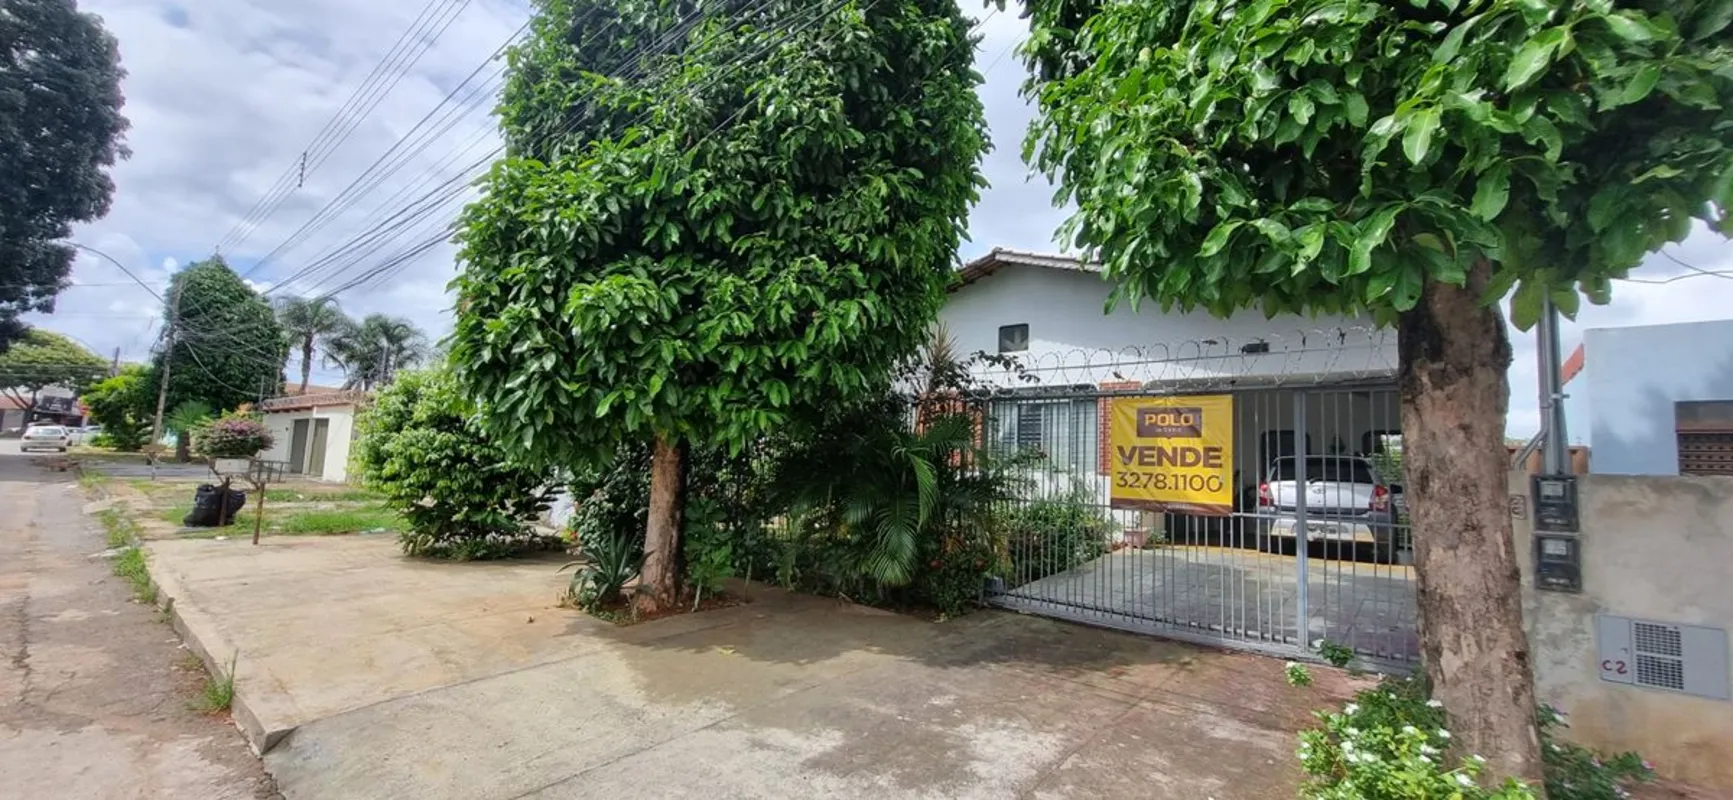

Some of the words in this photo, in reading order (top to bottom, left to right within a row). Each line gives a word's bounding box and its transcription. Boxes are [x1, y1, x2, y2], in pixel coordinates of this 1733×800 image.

[1144, 413, 1193, 426] POLO
[1117, 445, 1223, 468] VENDE
[1116, 471, 1223, 493] 3278.1100
